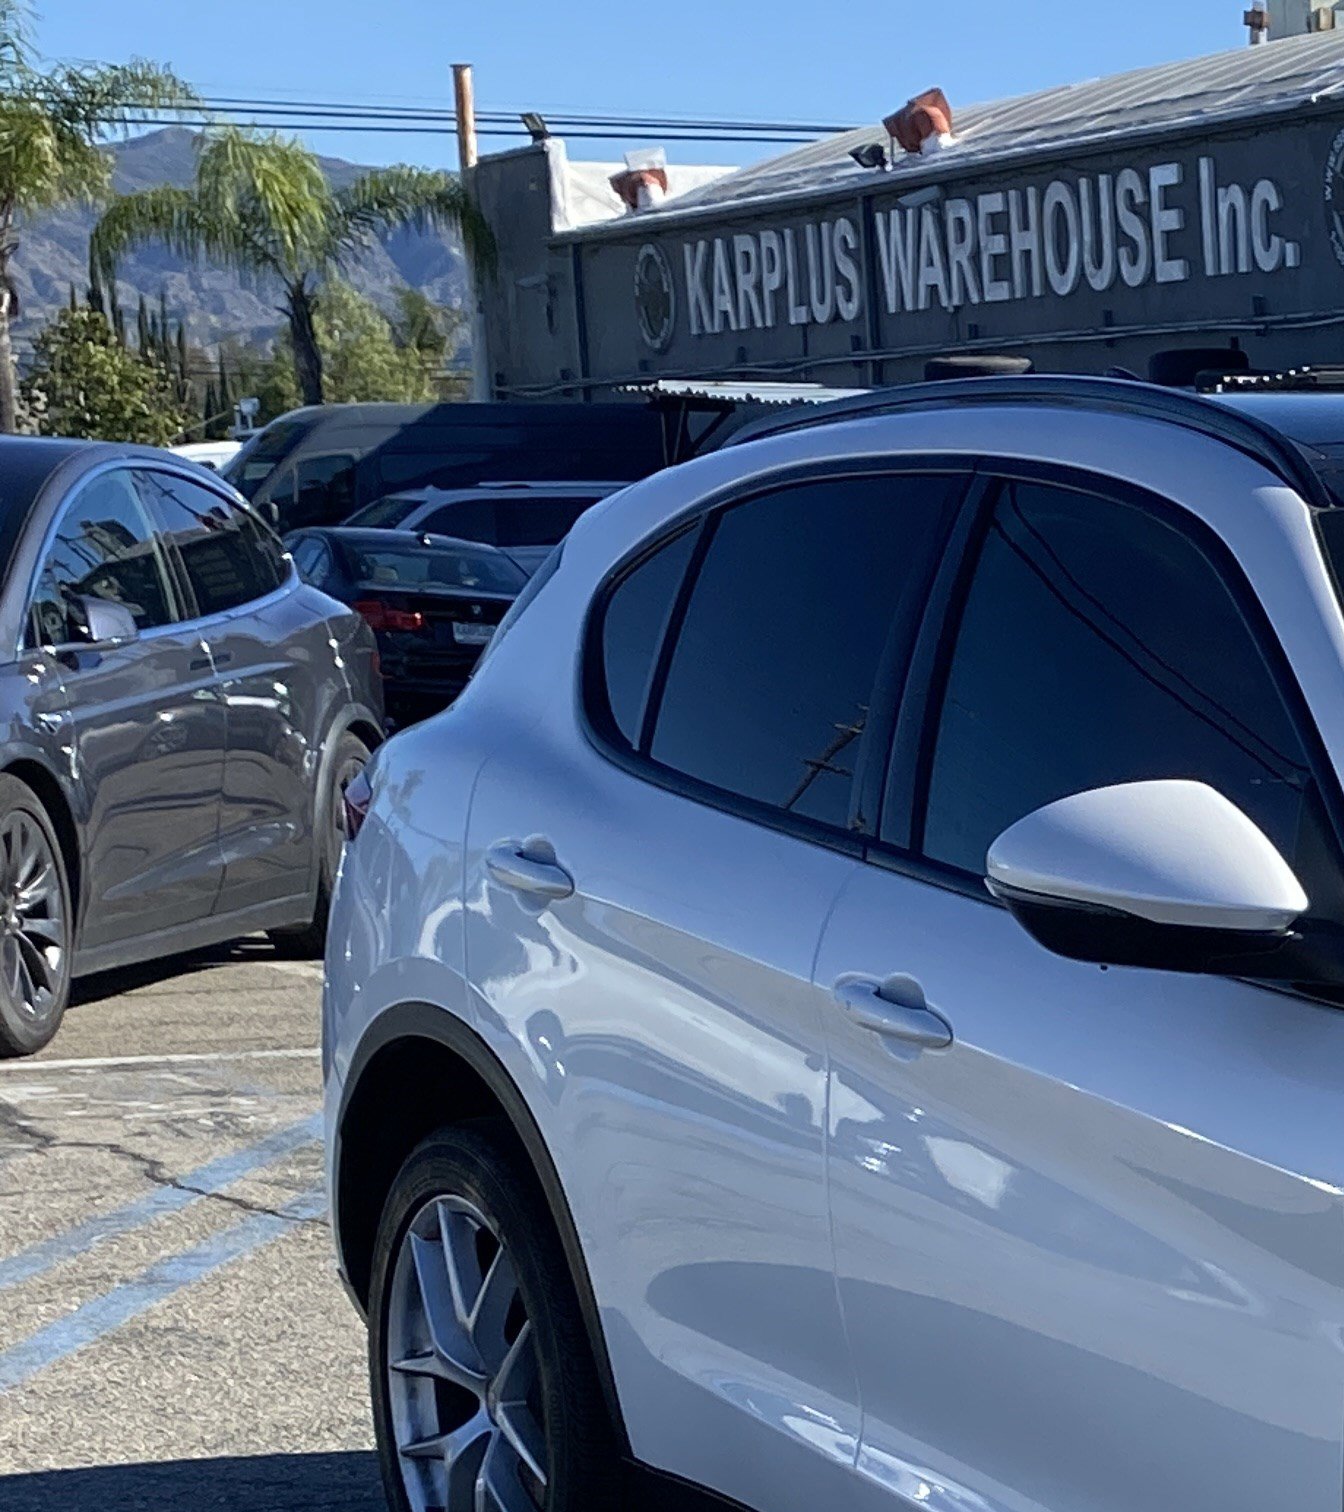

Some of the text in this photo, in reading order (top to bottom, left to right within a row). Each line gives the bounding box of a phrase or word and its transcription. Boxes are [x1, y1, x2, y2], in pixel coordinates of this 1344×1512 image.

[683, 218, 862, 336] KARPLUS
[875, 163, 1190, 315] WAREHOUSE
[1200, 156, 1299, 277] Inc.
